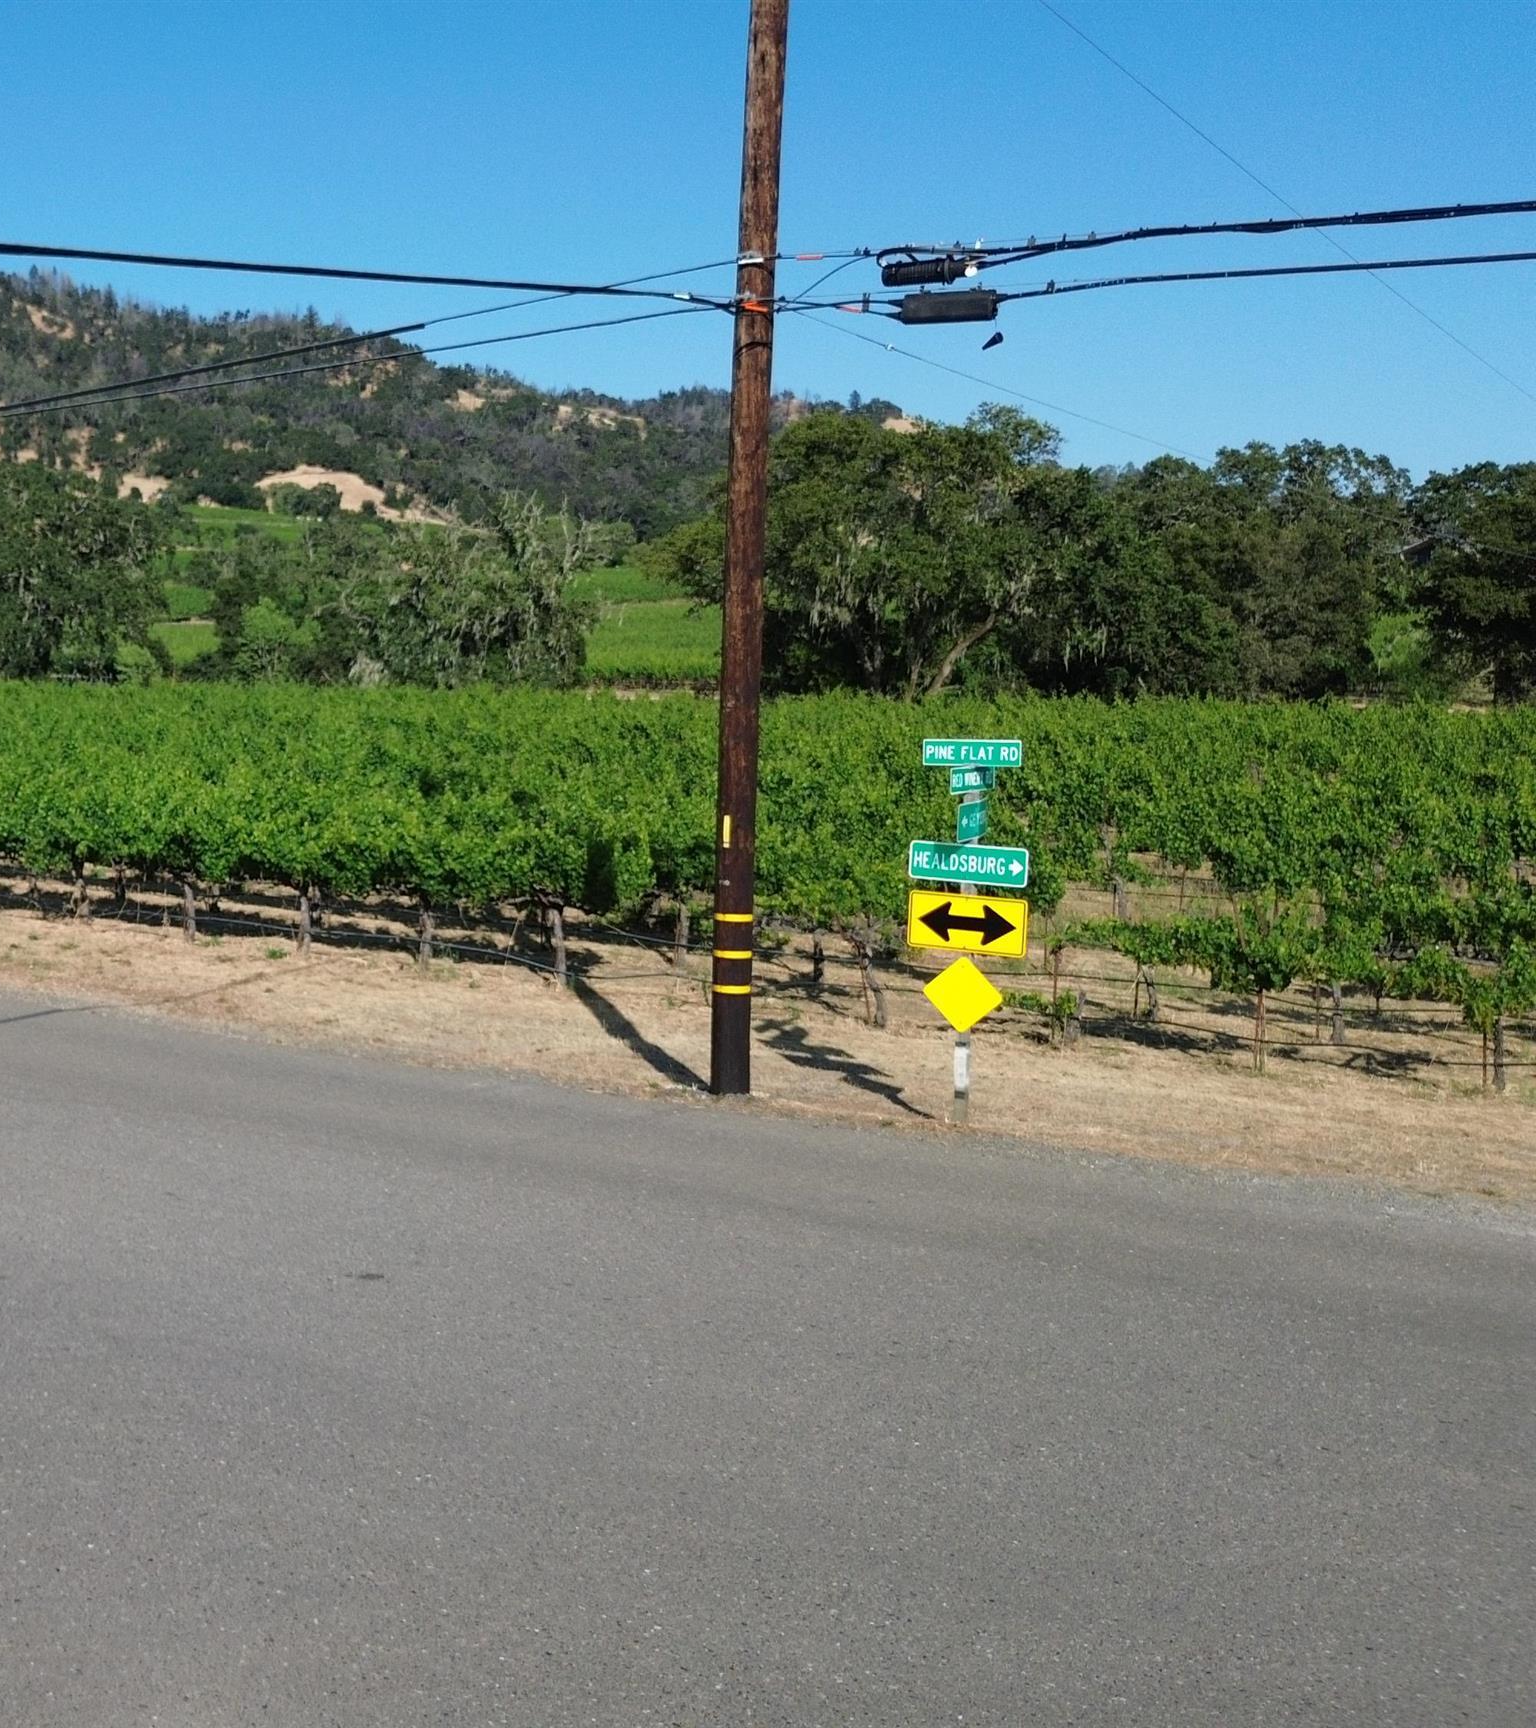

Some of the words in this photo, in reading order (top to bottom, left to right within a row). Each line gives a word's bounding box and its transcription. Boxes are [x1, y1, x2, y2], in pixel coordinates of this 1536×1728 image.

[925, 744, 956, 760] PINE
[960, 745, 994, 761] FLAT
[1000, 746, 1019, 762] RD
[914, 850, 1006, 875] HEALDSBURG
